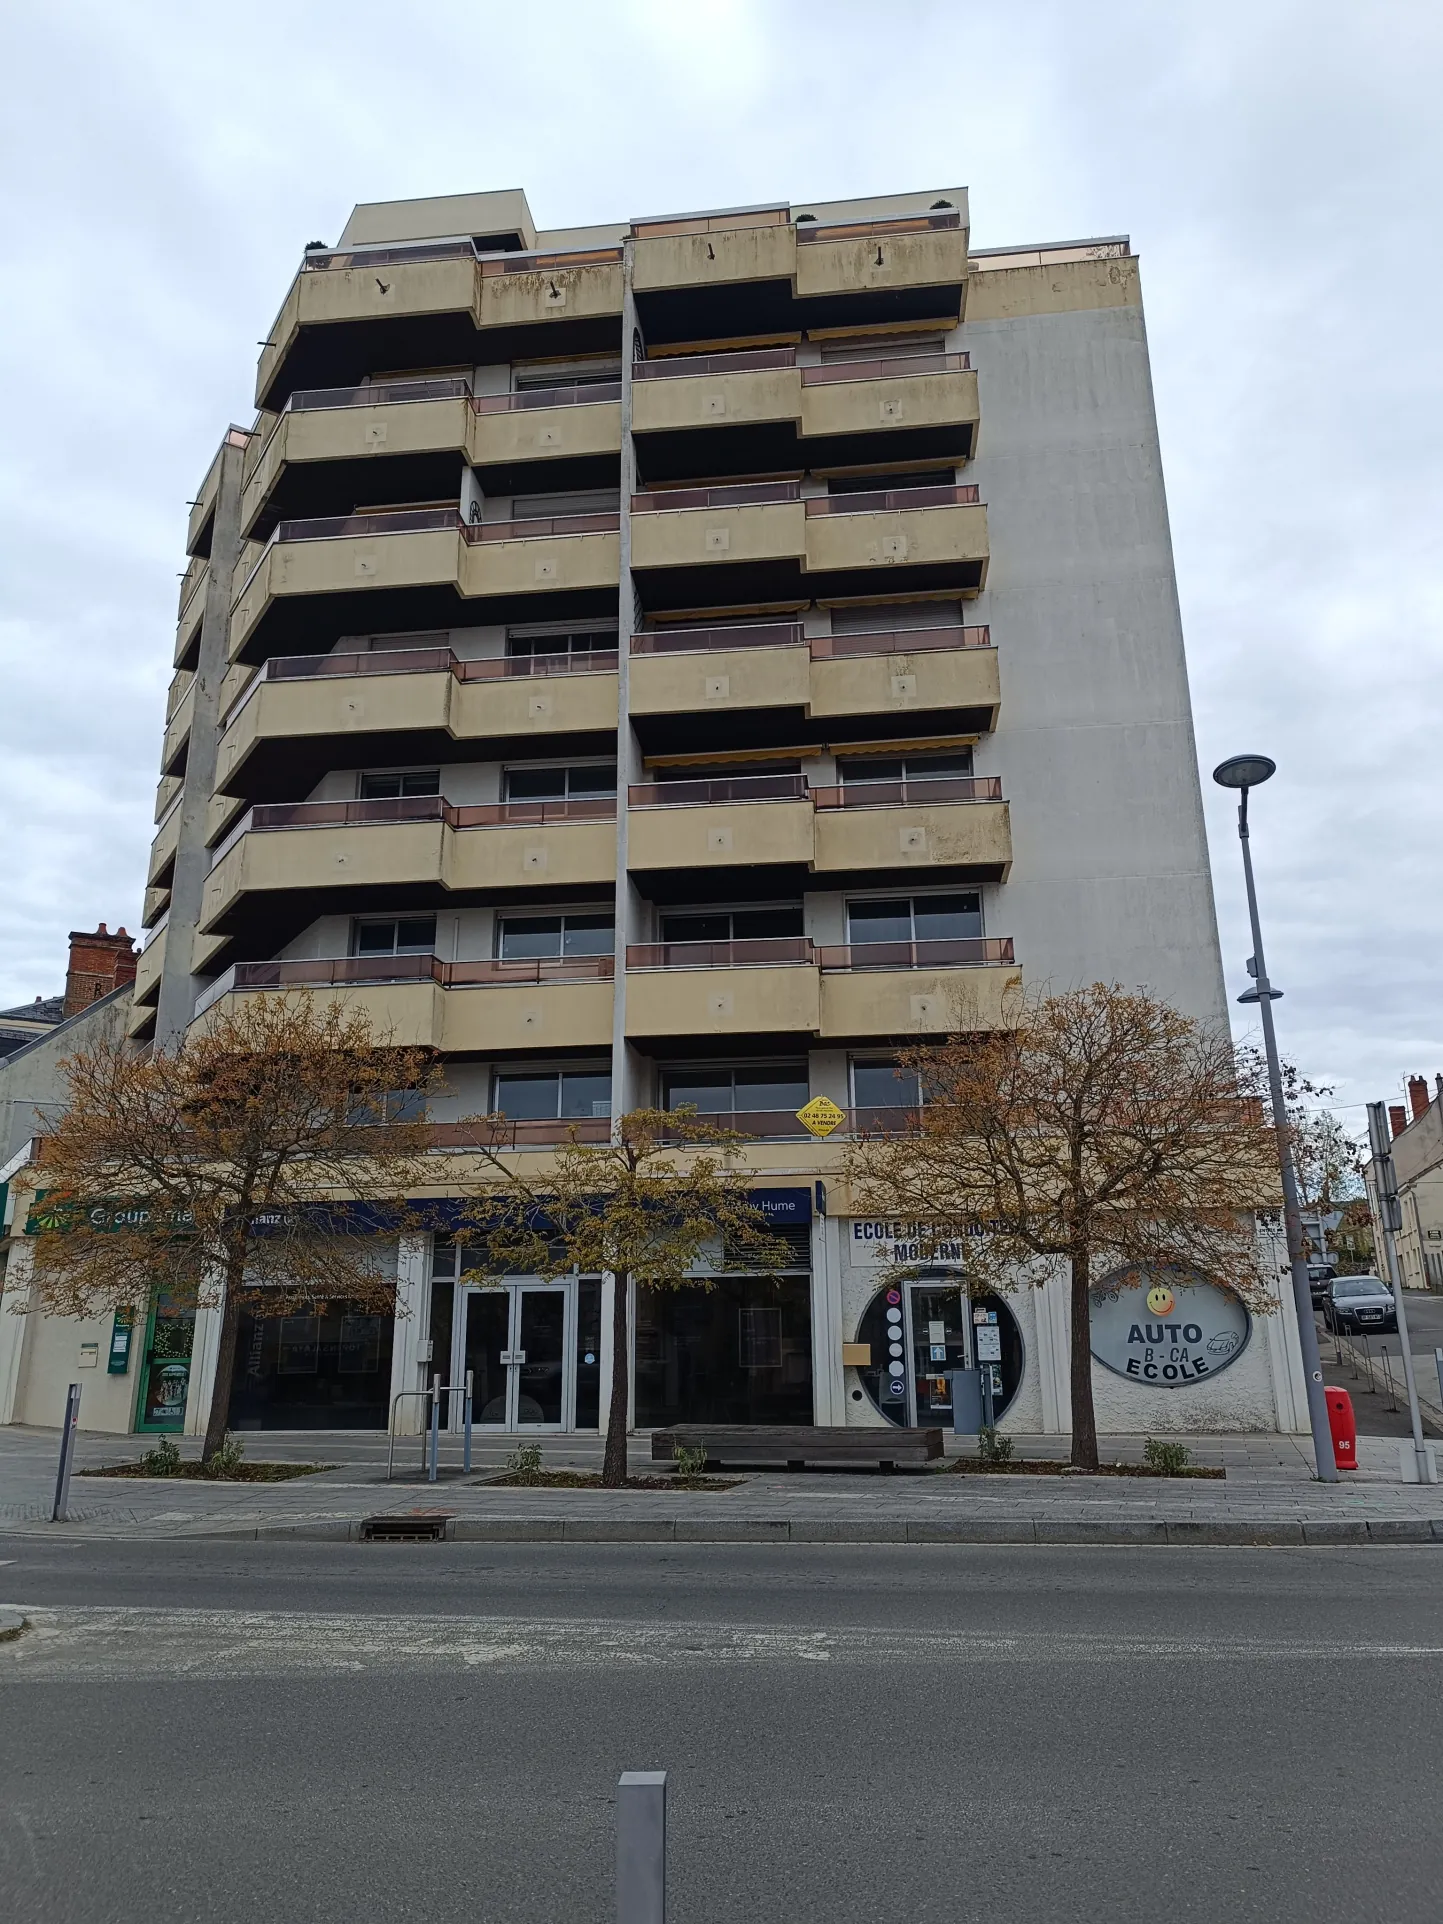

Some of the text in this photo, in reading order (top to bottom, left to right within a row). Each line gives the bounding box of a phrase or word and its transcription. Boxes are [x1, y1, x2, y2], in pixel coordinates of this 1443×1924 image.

[762, 1200, 795, 1211] Hume
[90, 1208, 193, 1225] Groupma
[854, 1221, 900, 1240] ECOLE
[1127, 1323, 1203, 1344] AUTO
[1144, 1347, 1154, 1363] B
[1169, 1347, 1189, 1363] CA
[1126, 1356, 1209, 1379] ECOLE
[1338, 1440, 1351, 1450] 95
